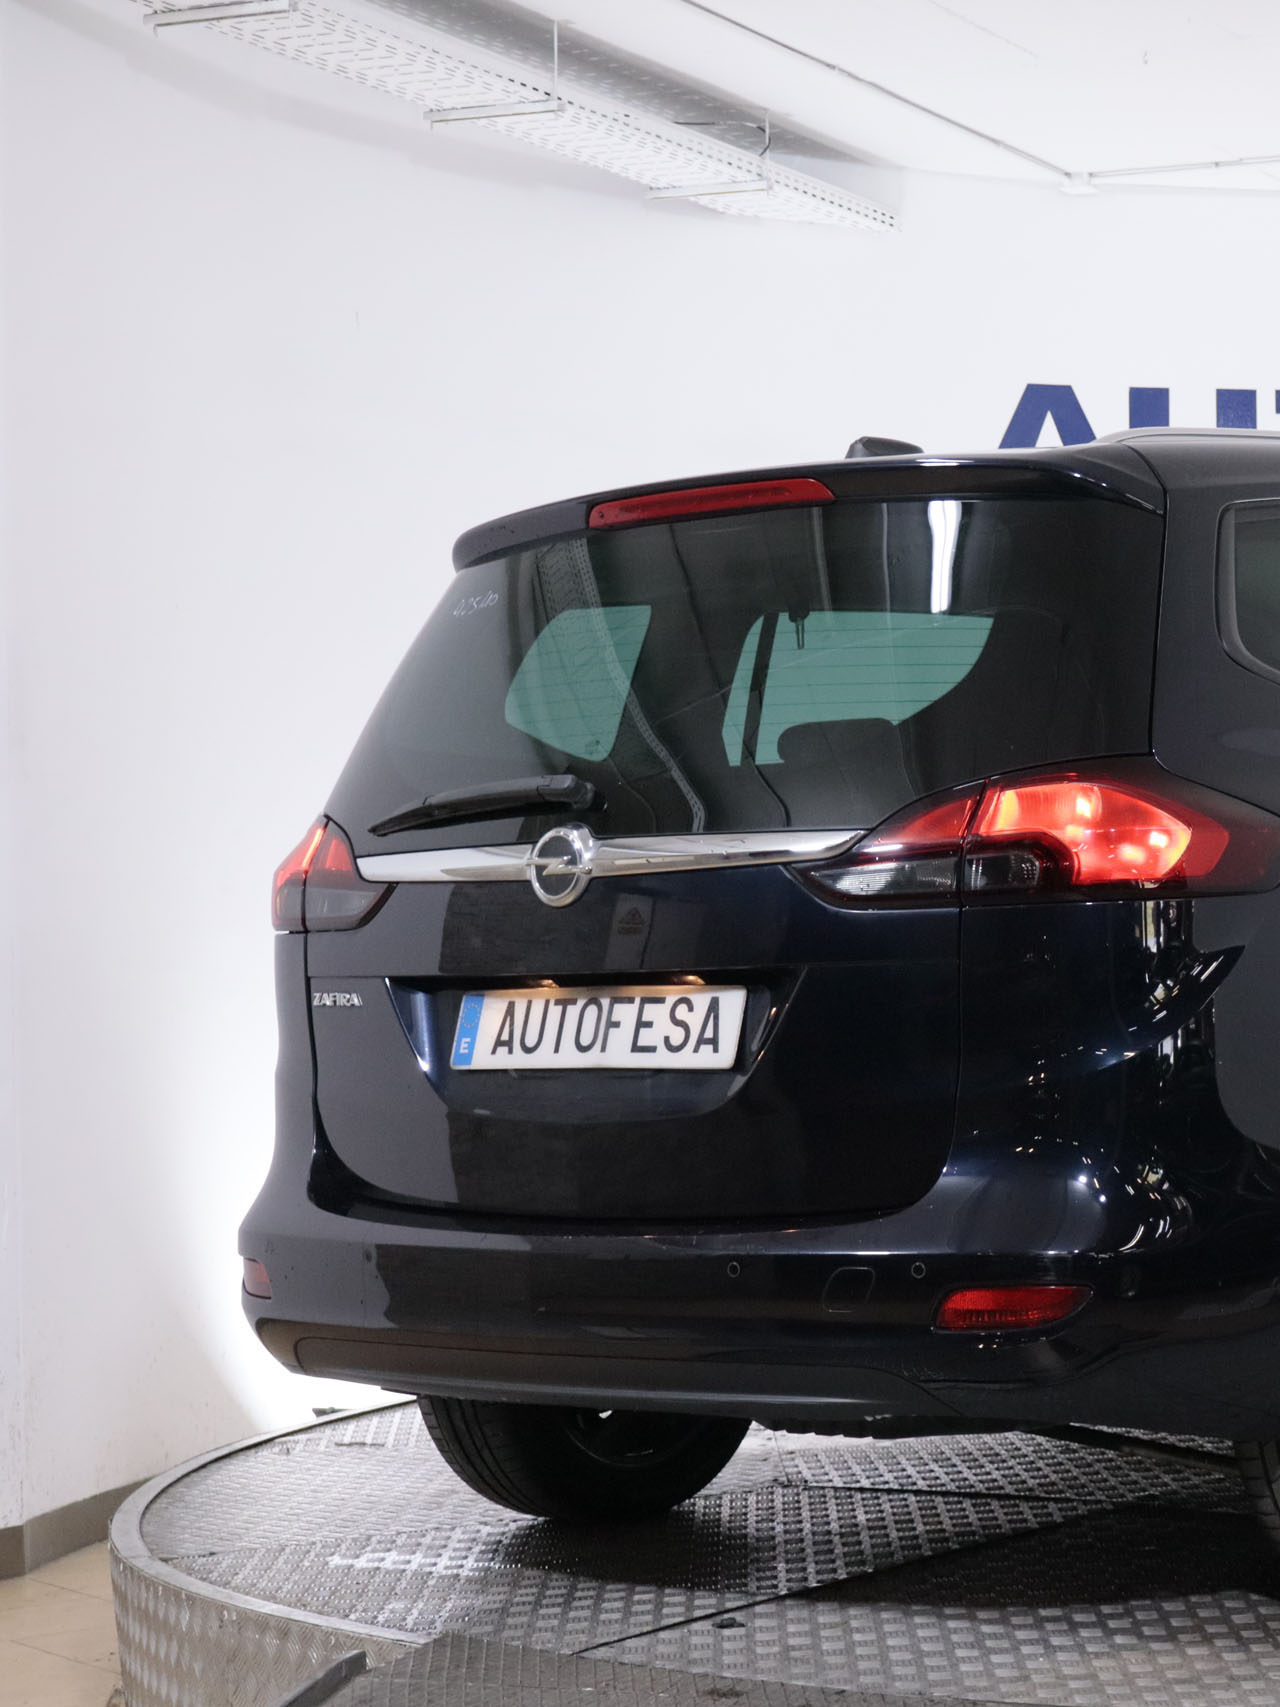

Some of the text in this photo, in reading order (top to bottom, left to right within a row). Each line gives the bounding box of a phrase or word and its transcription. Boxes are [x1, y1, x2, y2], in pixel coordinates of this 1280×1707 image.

[312, 991, 363, 1007] ZAFIRA
[490, 996, 720, 1055] AUTOFESA
[459, 1037, 472, 1054] E
